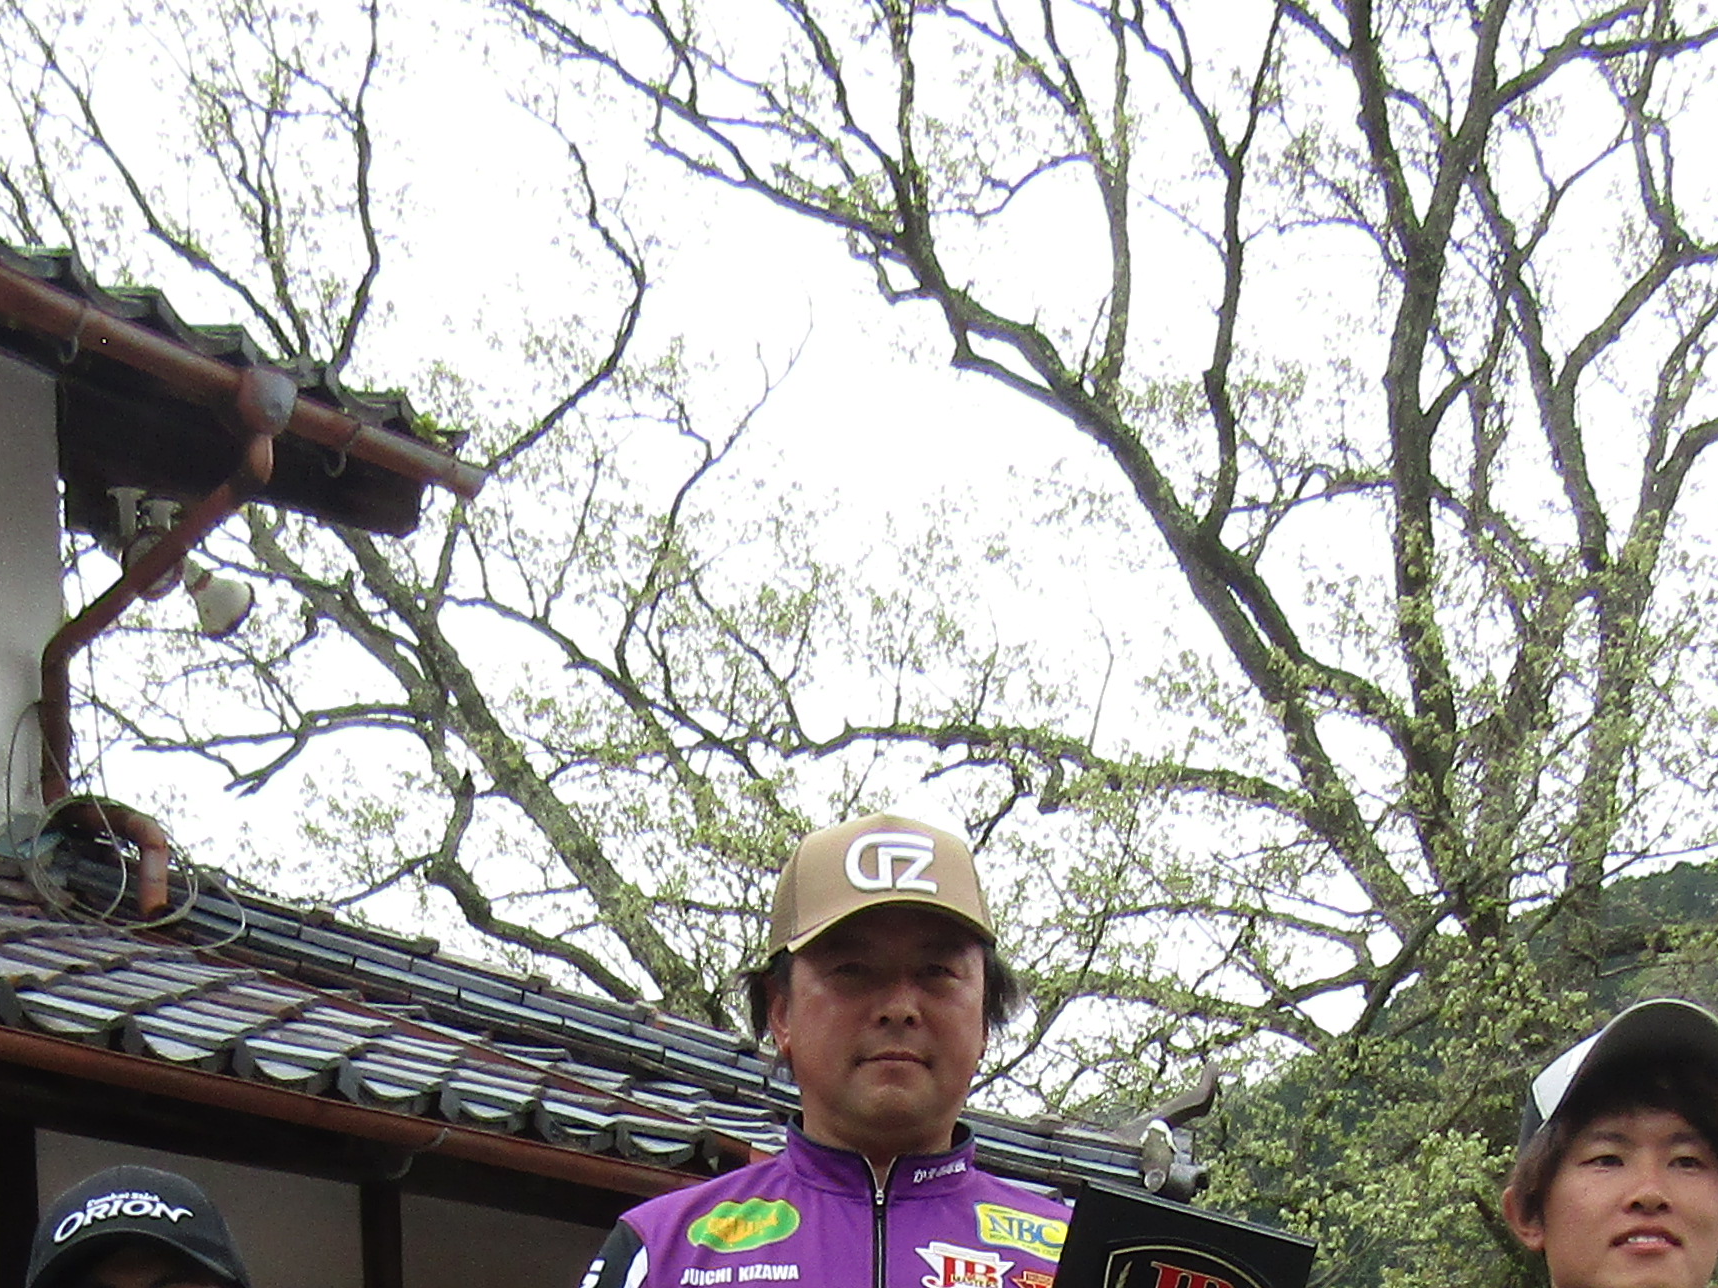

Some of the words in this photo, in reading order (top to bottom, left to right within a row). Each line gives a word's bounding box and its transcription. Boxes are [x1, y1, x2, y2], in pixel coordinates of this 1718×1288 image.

[54, 1200, 194, 1243] ORION
[987, 1214, 1066, 1249] NBC
[680, 1267, 732, 1287] JUICHI
[738, 1263, 800, 1283] KIZAWA
